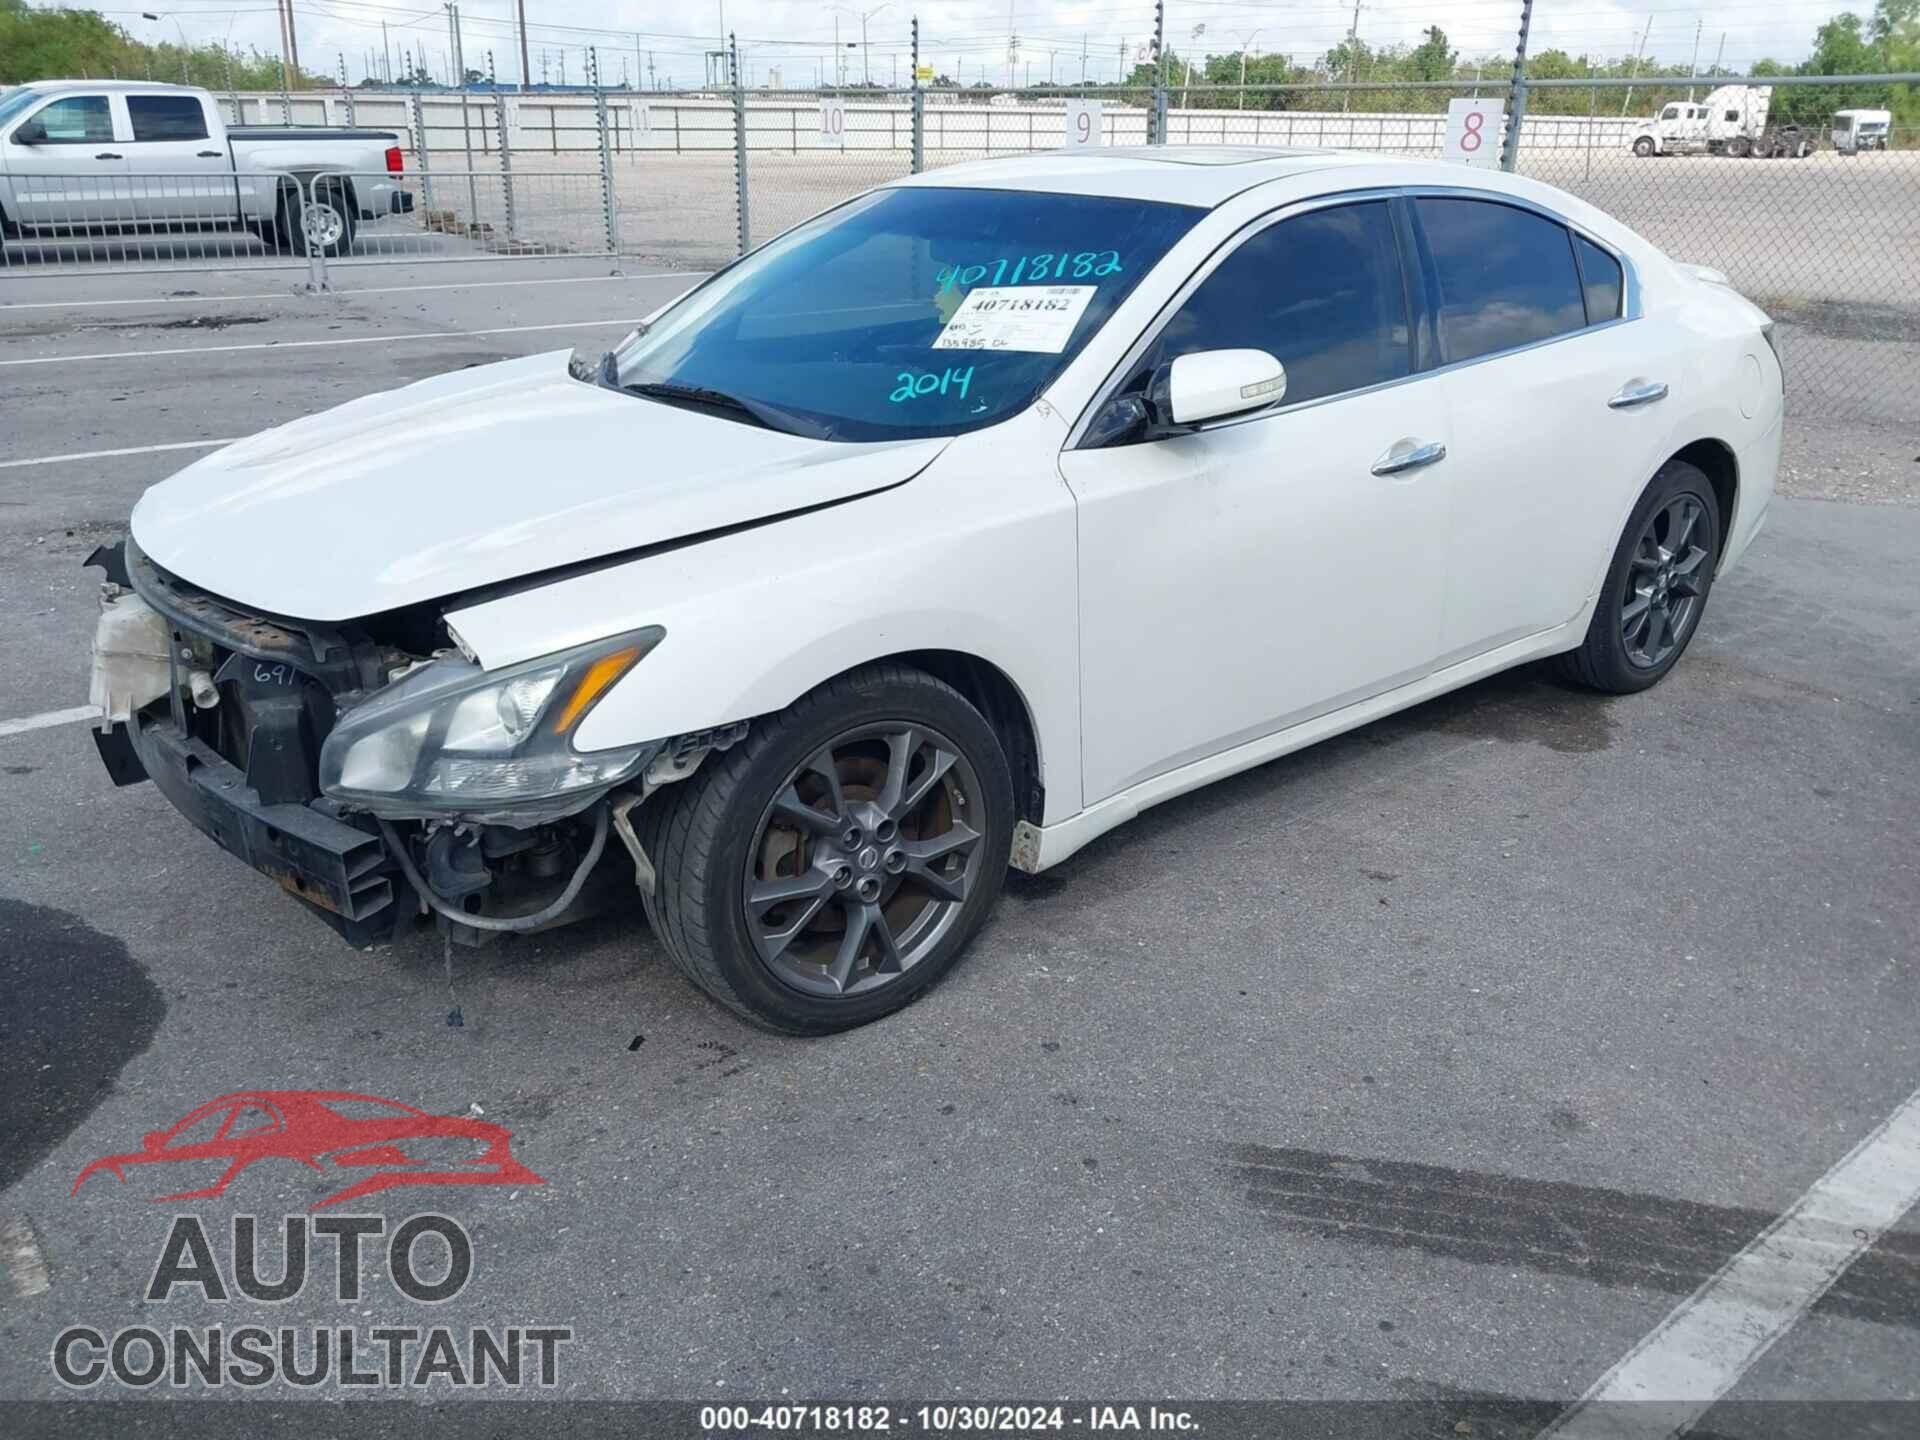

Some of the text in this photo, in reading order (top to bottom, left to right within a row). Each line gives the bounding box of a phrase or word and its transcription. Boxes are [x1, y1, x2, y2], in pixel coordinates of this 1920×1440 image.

[822, 107, 843, 135] 10
[1077, 112, 1090, 143] 9
[1460, 112, 1483, 152] 8
[937, 250, 1122, 294] 40718182
[972, 298, 1071, 311] 40718182
[889, 366, 974, 402] 2014
